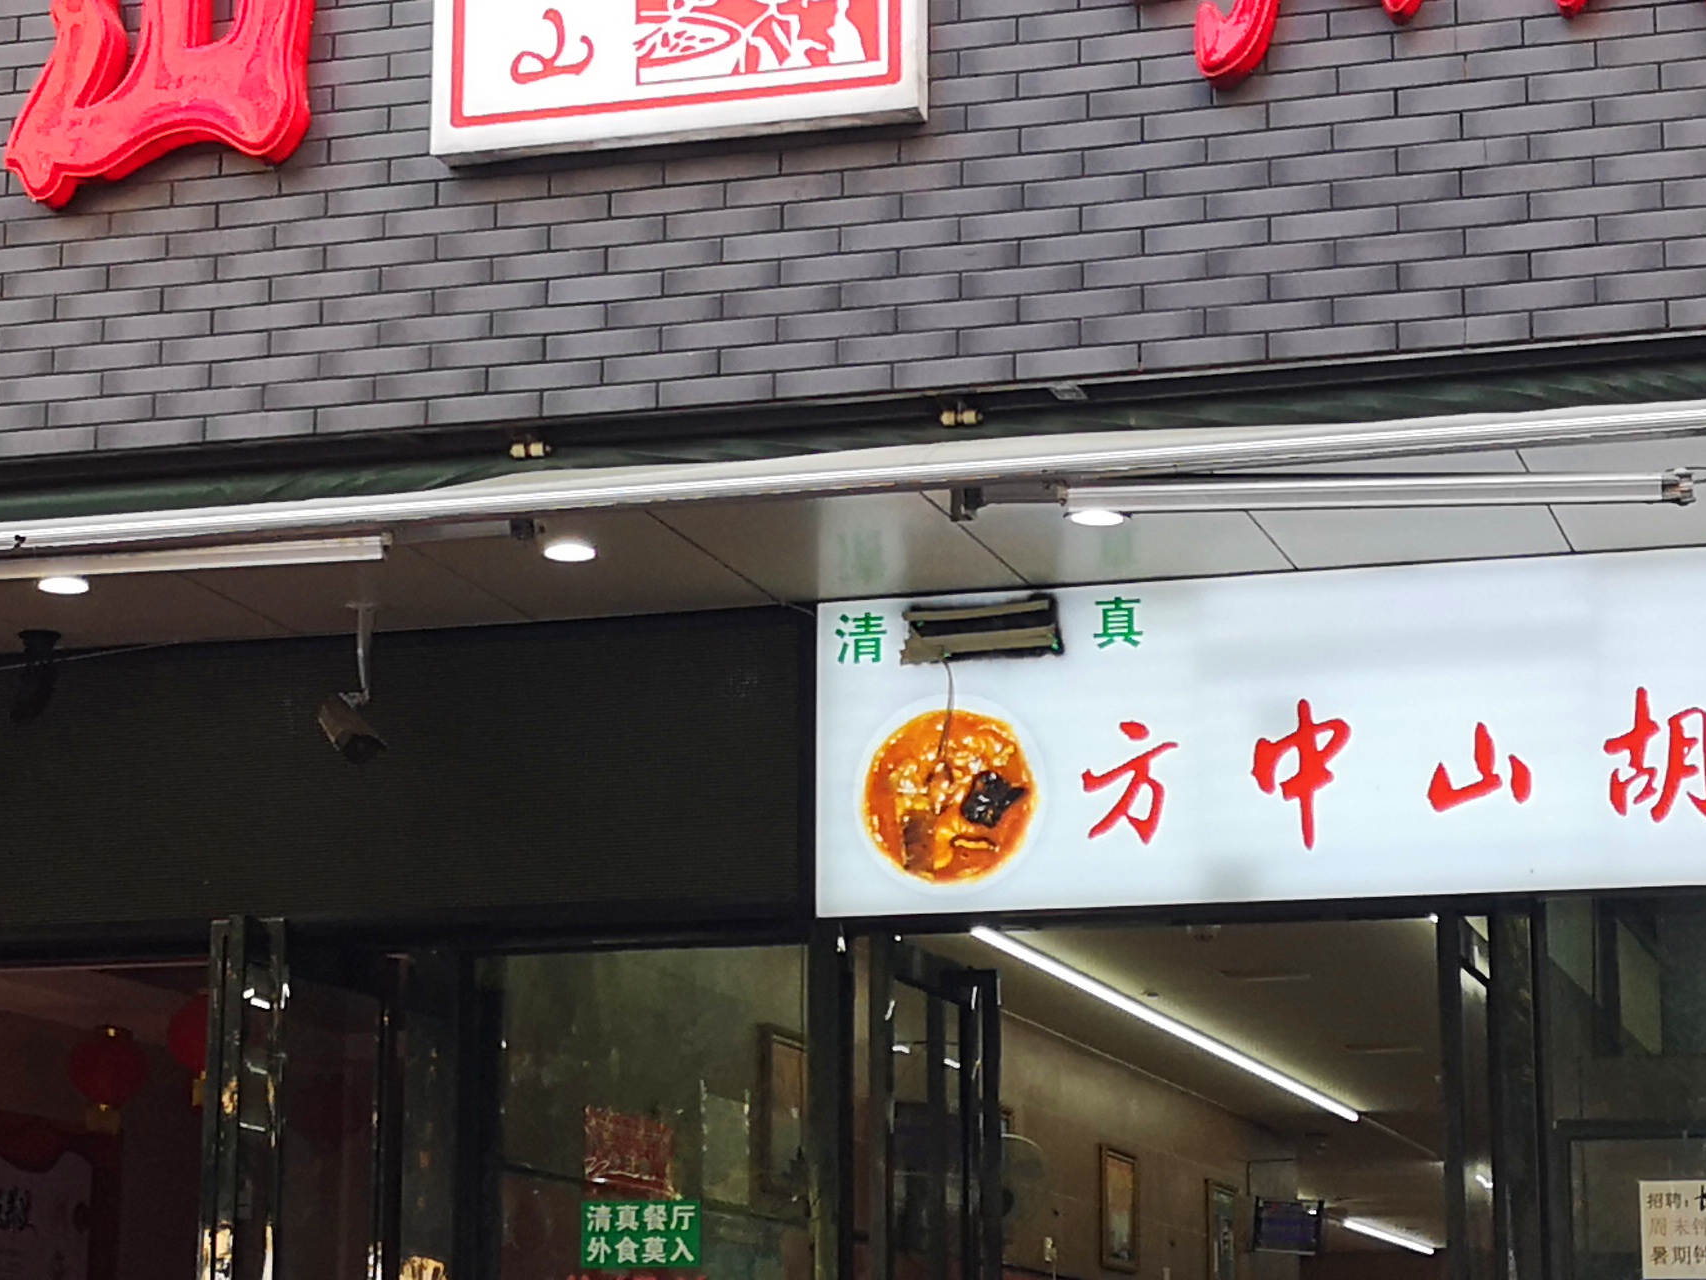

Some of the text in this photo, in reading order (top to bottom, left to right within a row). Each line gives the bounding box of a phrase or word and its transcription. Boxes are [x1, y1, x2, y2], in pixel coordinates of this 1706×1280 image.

[586, 1204, 696, 1234] 清真餐厅
[586, 1235, 695, 1265] 外食莫入
